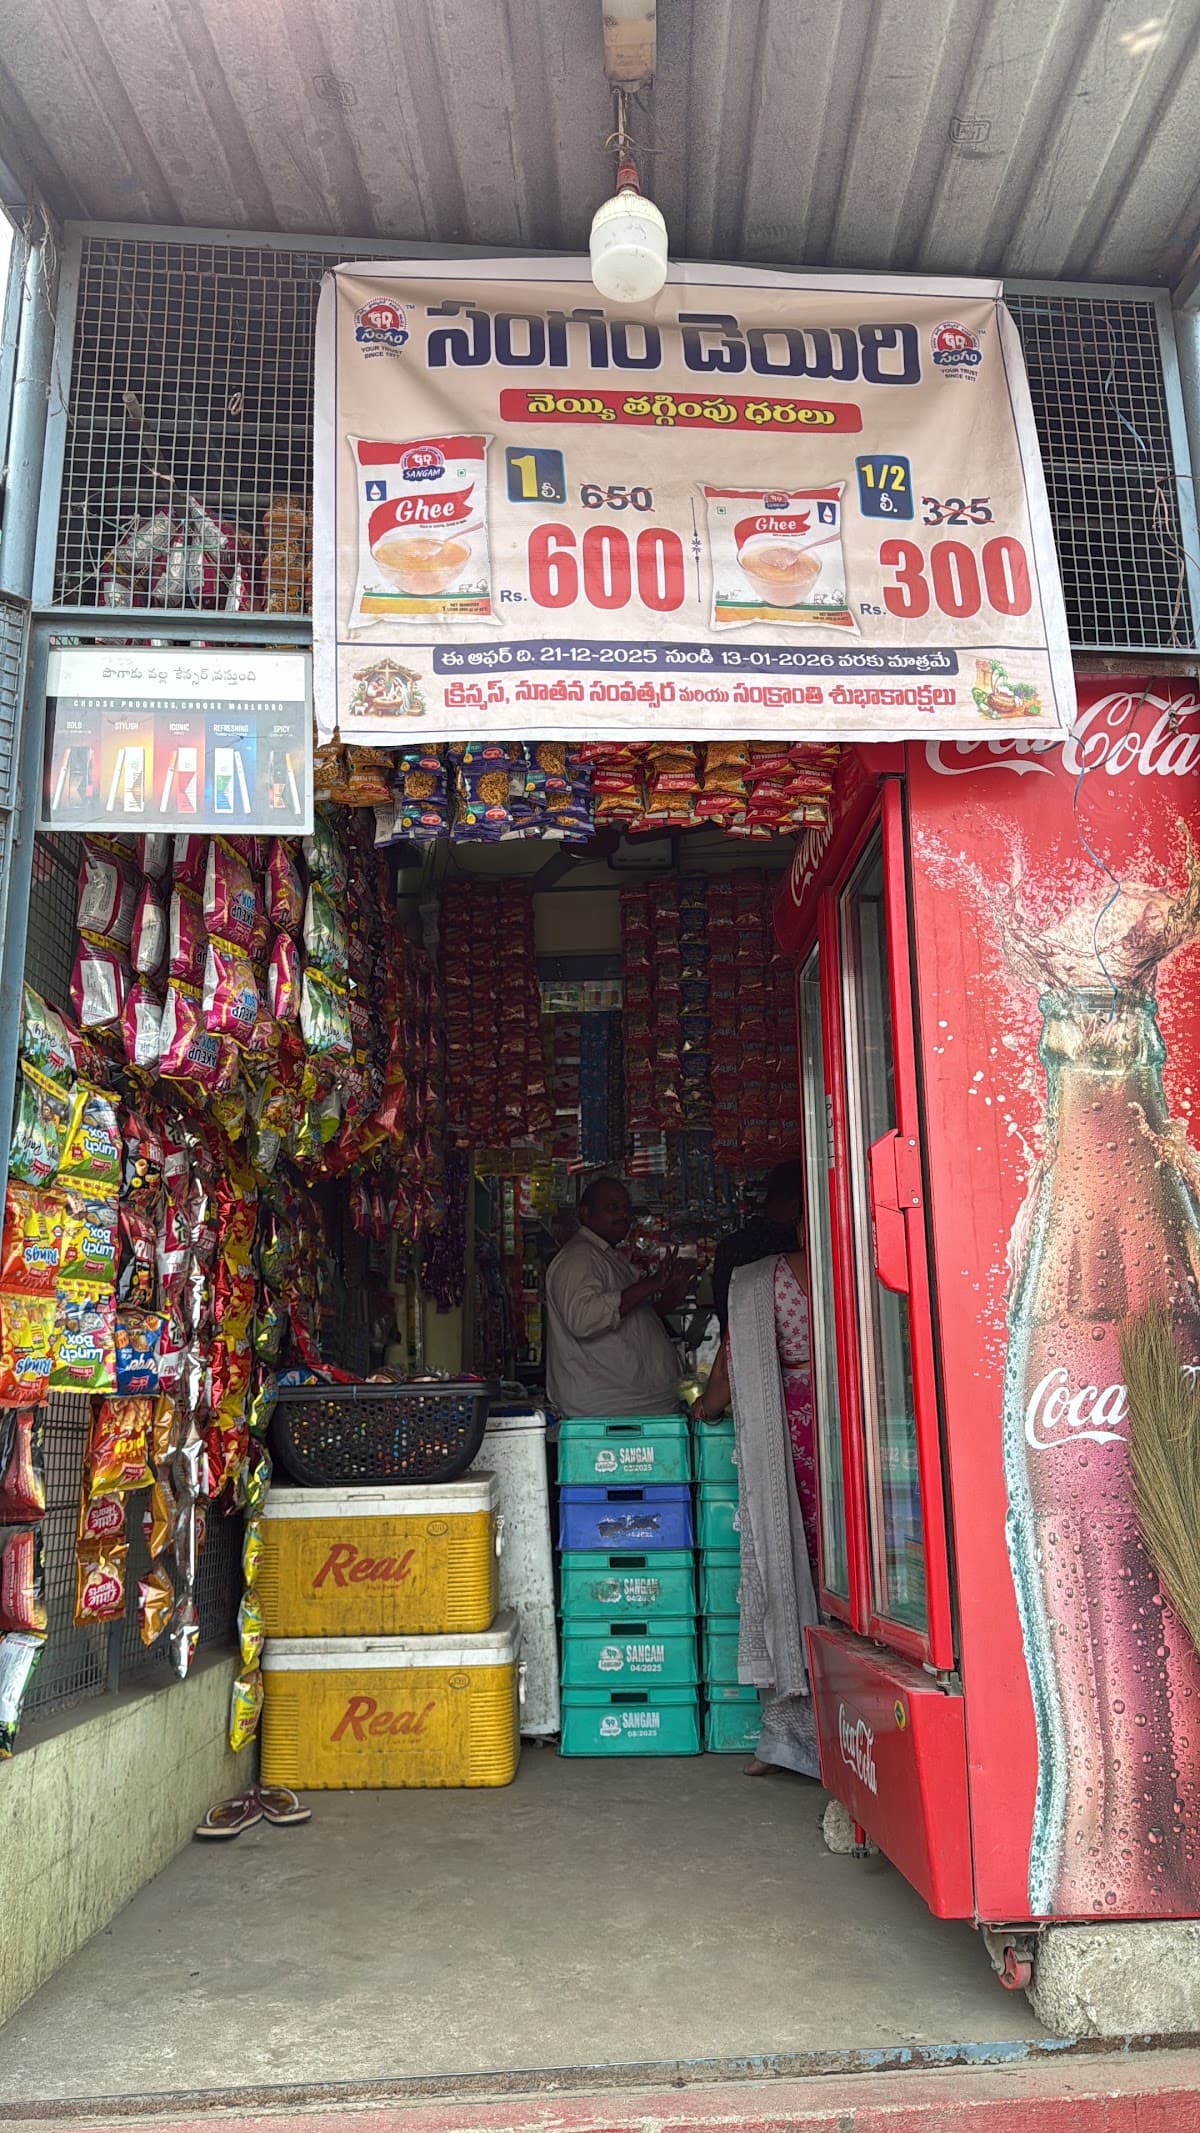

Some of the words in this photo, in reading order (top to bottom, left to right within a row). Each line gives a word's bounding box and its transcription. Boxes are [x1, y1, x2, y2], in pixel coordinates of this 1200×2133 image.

[427, 300, 663, 370] సంగం
[678, 312, 921, 385] డెయిరి
[526, 393, 617, 422] నెయ్యి
[623, 395, 738, 426] తగ్గింపు
[745, 401, 835, 425] ధరలు
[404, 468, 442, 479] SANGAM
[510, 455, 539, 499] 1
[861, 464, 906, 492] 1/2
[580, 484, 654, 512] 650
[395, 498, 455, 522] Ghee
[921, 496, 995, 527] 325
[755, 517, 797, 531] Ghee
[500, 590, 528, 603] Rs.
[528, 522, 686, 612] 600
[860, 603, 887, 616] Rs.
[879, 535, 1033, 619] 300
[441, 652, 465, 666] ఈ
[467, 648, 512, 668] ఆఫర్
[540, 647, 658, 664] 21-12-2025
[665, 648, 714, 664] నుండి
[722, 651, 835, 667] 13-01-2026
[838, 654, 884, 668] వరకు
[888, 652, 951, 671] మాత్రమే
[147, 668, 168, 684] వల్ల
[73, 700, 115, 708] CHOOSE
[181, 702, 222, 710] CHOOSE
[515, 680, 584, 701] నూతన
[590, 680, 676, 709] సంవత్సర
[679, 687, 729, 702] మరియు
[733, 682, 823, 707] సంక్రాంతి
[828, 684, 956, 713] శుభాకాంక్షలు
[213, 724, 249, 733] REFRESHING
[231, 905, 255, 927] AKEUP
[231, 1006, 257, 1023] AKEUP
[187, 1048, 217, 1069] AKEUP
[84, 1138, 118, 1160] Lunch
[24, 1245, 58, 1265] Rings
[83, 1238, 114, 1258] Lunch
[67, 1333, 94, 1347] Box
[59, 1345, 103, 1364] Lunch
[16, 1356, 52, 1375] Rings
[113, 1430, 146, 1456] picy
[620, 1447, 655, 1464] SANGAM
[90, 1504, 116, 1522] Hearts
[91, 1515, 119, 1533] Little
[312, 1543, 417, 1589] Real
[88, 1580, 115, 1599] Hearts
[623, 1578, 659, 1595] SANGAM
[87, 1588, 118, 1607] Little
[626, 1645, 665, 1663] SANGAM
[329, 1695, 436, 1742] Real
[622, 1711, 660, 1729] SANGAM
